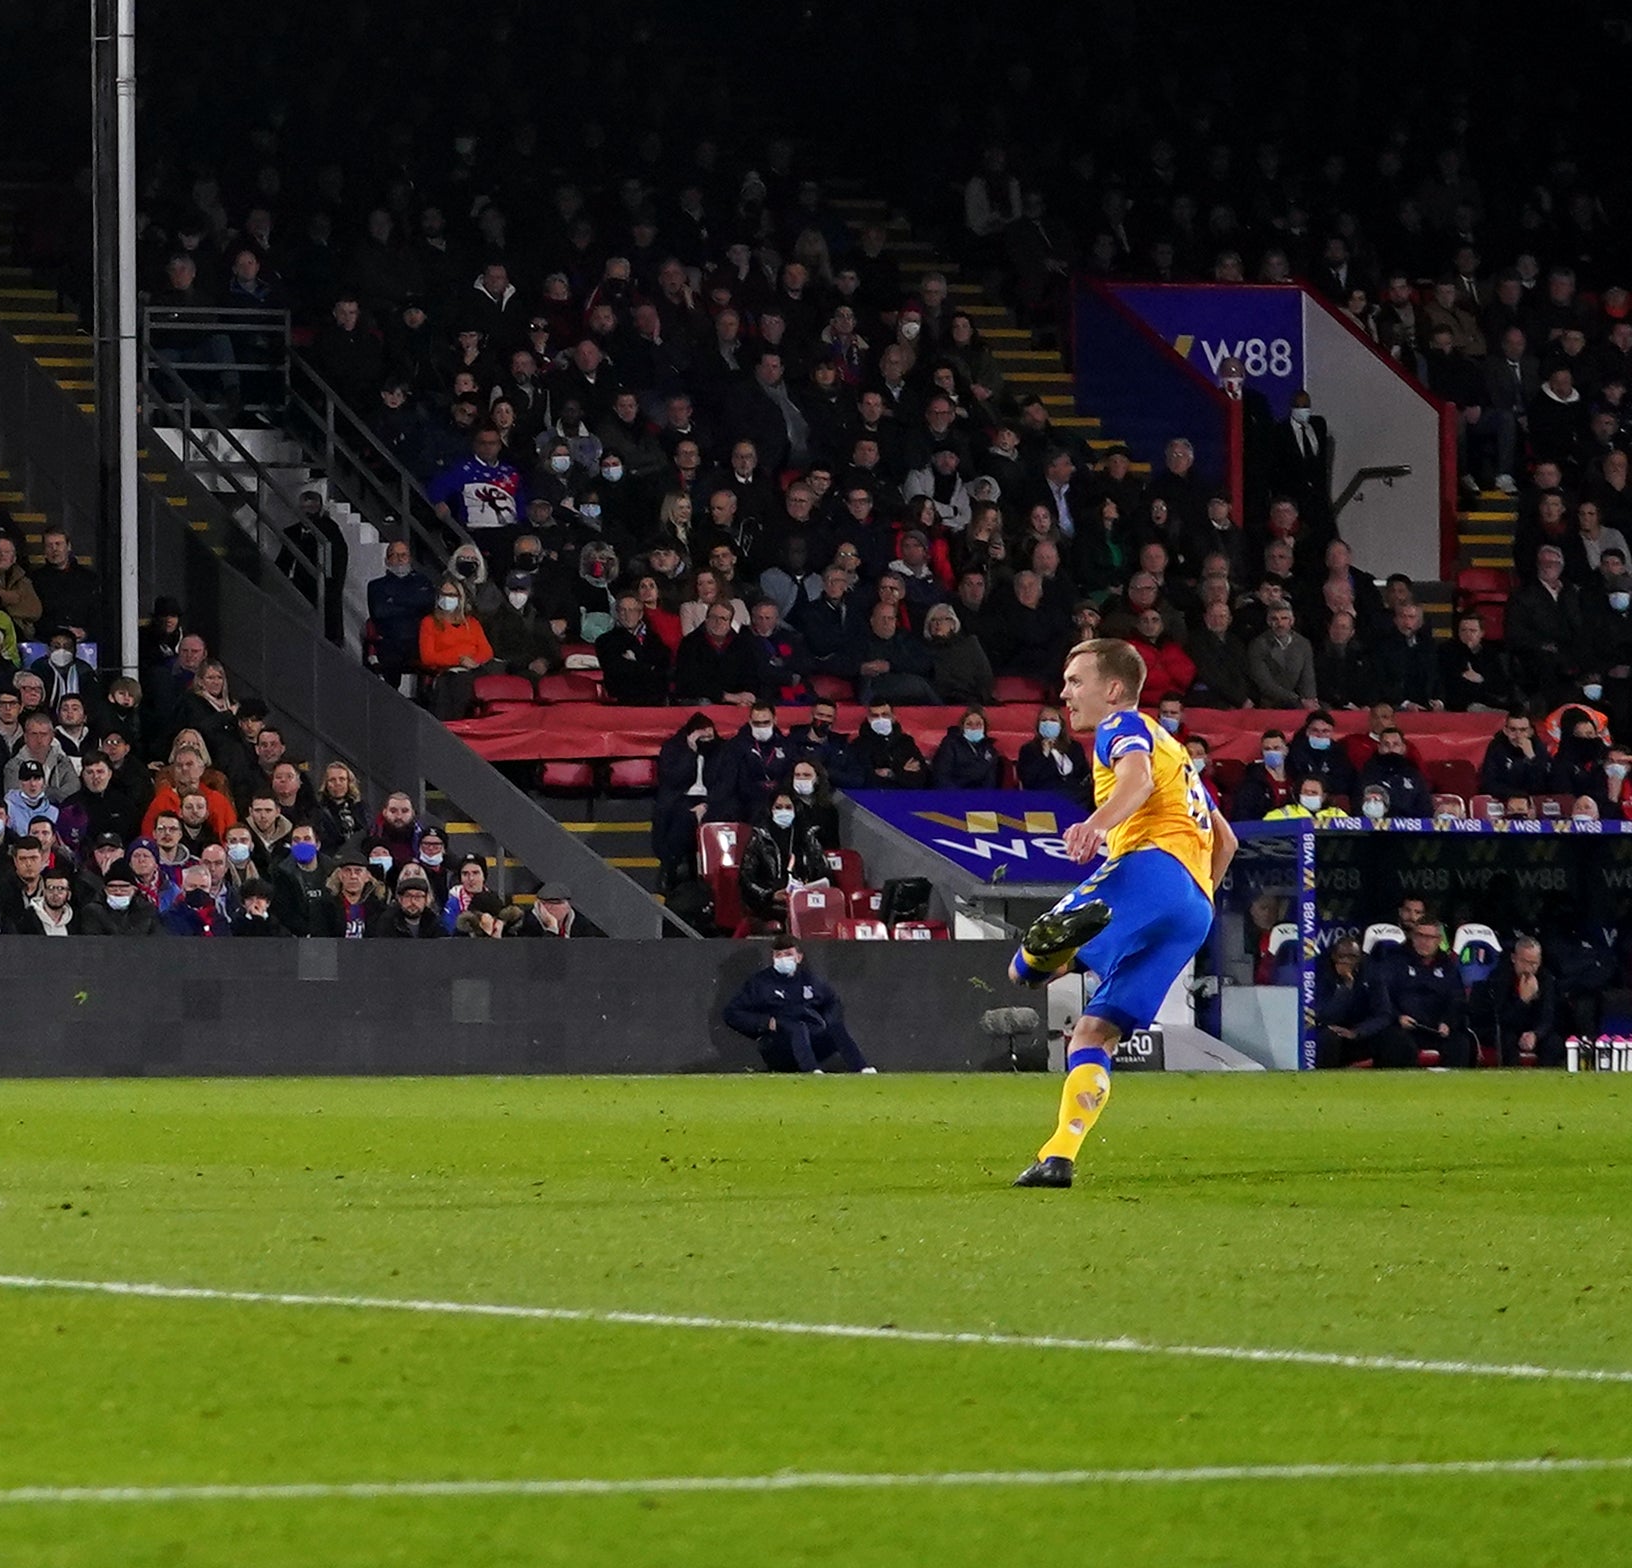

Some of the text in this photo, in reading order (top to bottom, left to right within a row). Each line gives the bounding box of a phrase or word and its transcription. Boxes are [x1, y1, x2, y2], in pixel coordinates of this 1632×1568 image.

[1200, 337, 1293, 378] W88
[1334, 817, 1363, 831] W88
[1394, 818, 1423, 831] W88
[1454, 818, 1482, 832] W88
[1513, 819, 1542, 832] W88
[1574, 820, 1603, 833] W88
[1303, 832, 1316, 866] W88
[1303, 901, 1316, 934] W88
[1303, 970, 1316, 1005] W88
